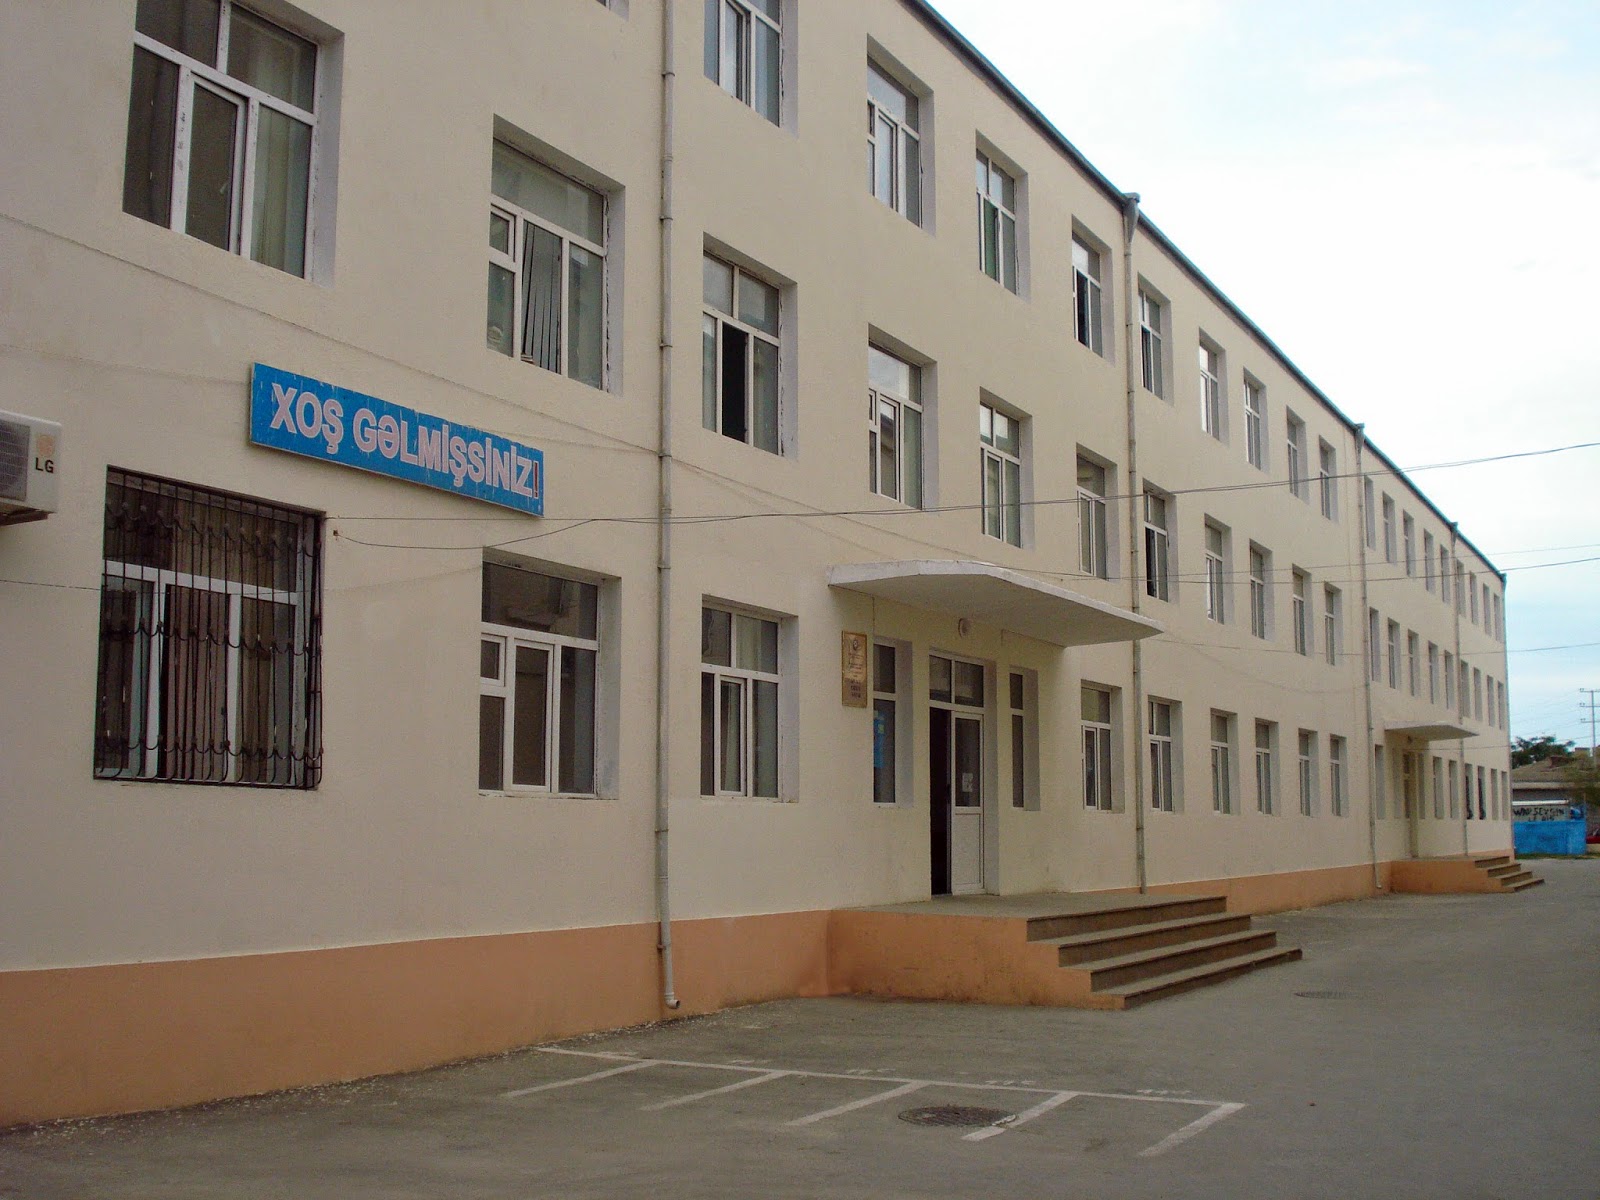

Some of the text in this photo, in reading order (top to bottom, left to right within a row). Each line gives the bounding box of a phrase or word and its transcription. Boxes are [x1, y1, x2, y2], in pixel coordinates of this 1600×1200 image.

[35, 457, 54, 474] LG
[271, 383, 539, 499] XOŞ GƏLMİŞSİNİZ!
